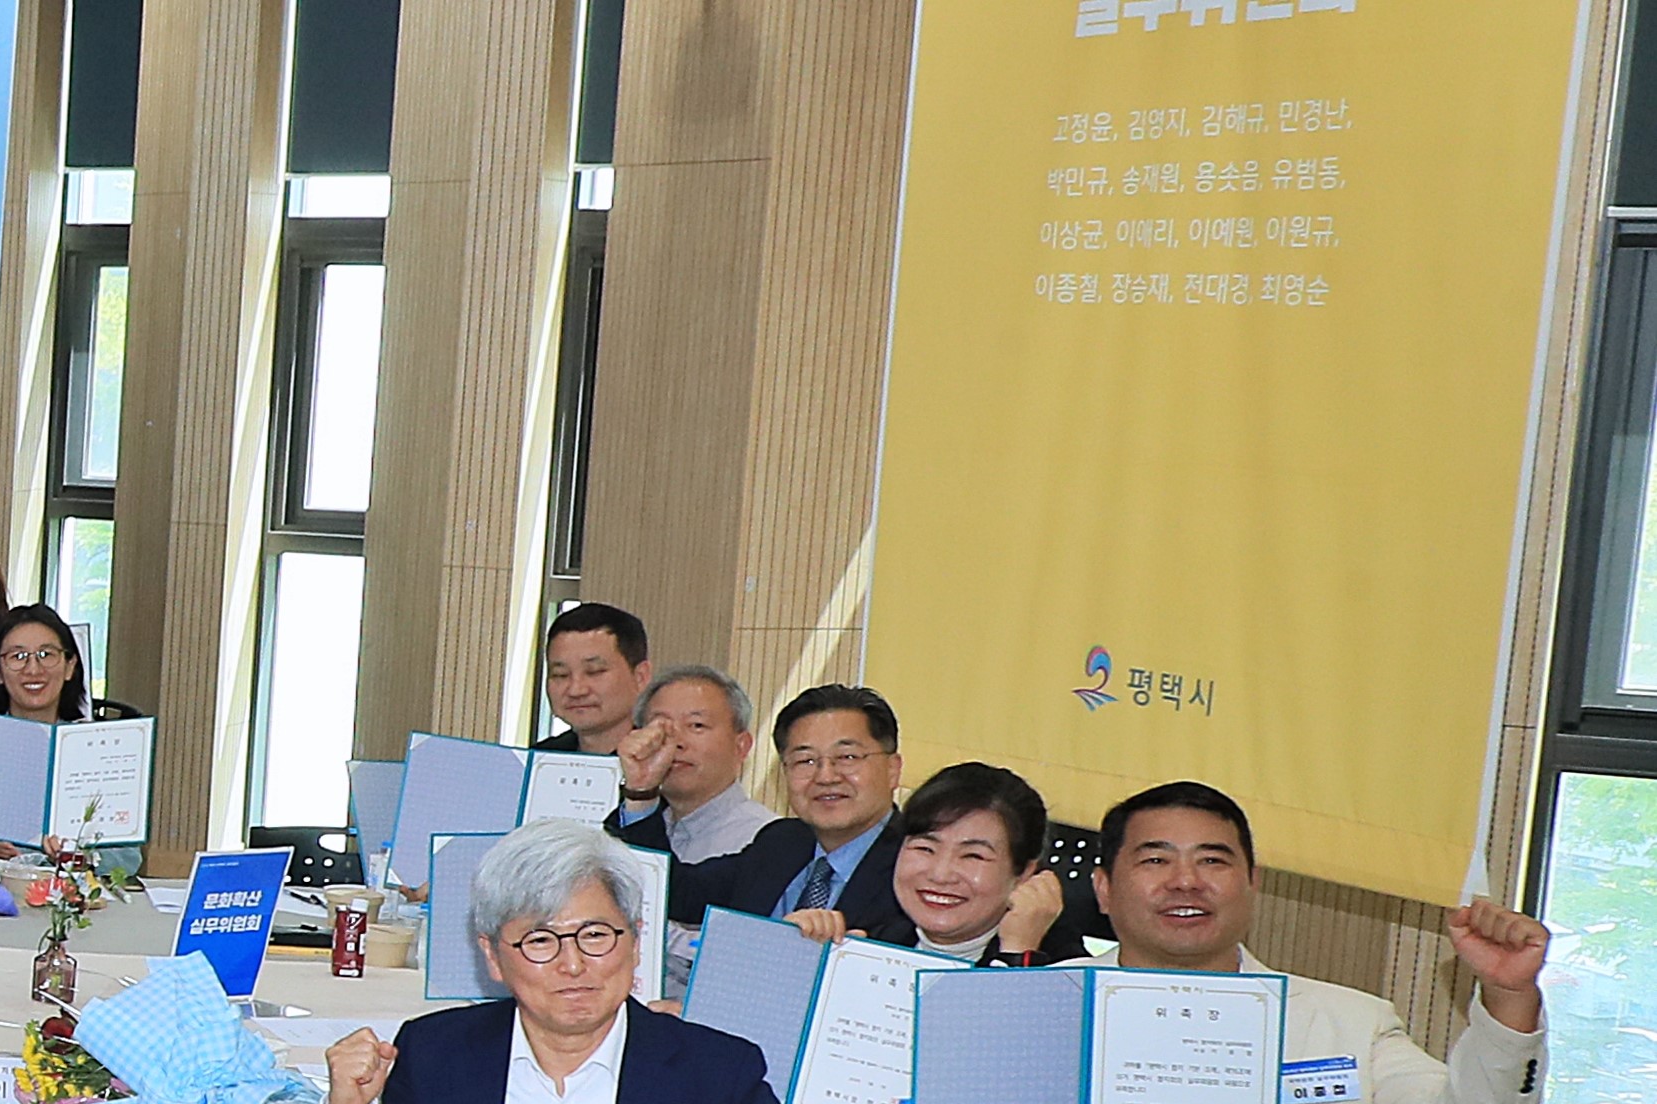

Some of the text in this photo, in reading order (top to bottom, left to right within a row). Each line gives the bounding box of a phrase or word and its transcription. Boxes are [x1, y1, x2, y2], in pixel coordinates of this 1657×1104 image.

[1047, 166, 1114, 197] 박민규,
[1122, 163, 1185, 195] 송재원,
[1271, 156, 1346, 190] 유범동,
[1266, 216, 1339, 248] 이원규,
[1261, 274, 1329, 306] 최영순
[1126, 665, 1216, 717] 평택시
[203, 890, 262, 909] 문화확산
[190, 914, 262, 935] 실무위원회
